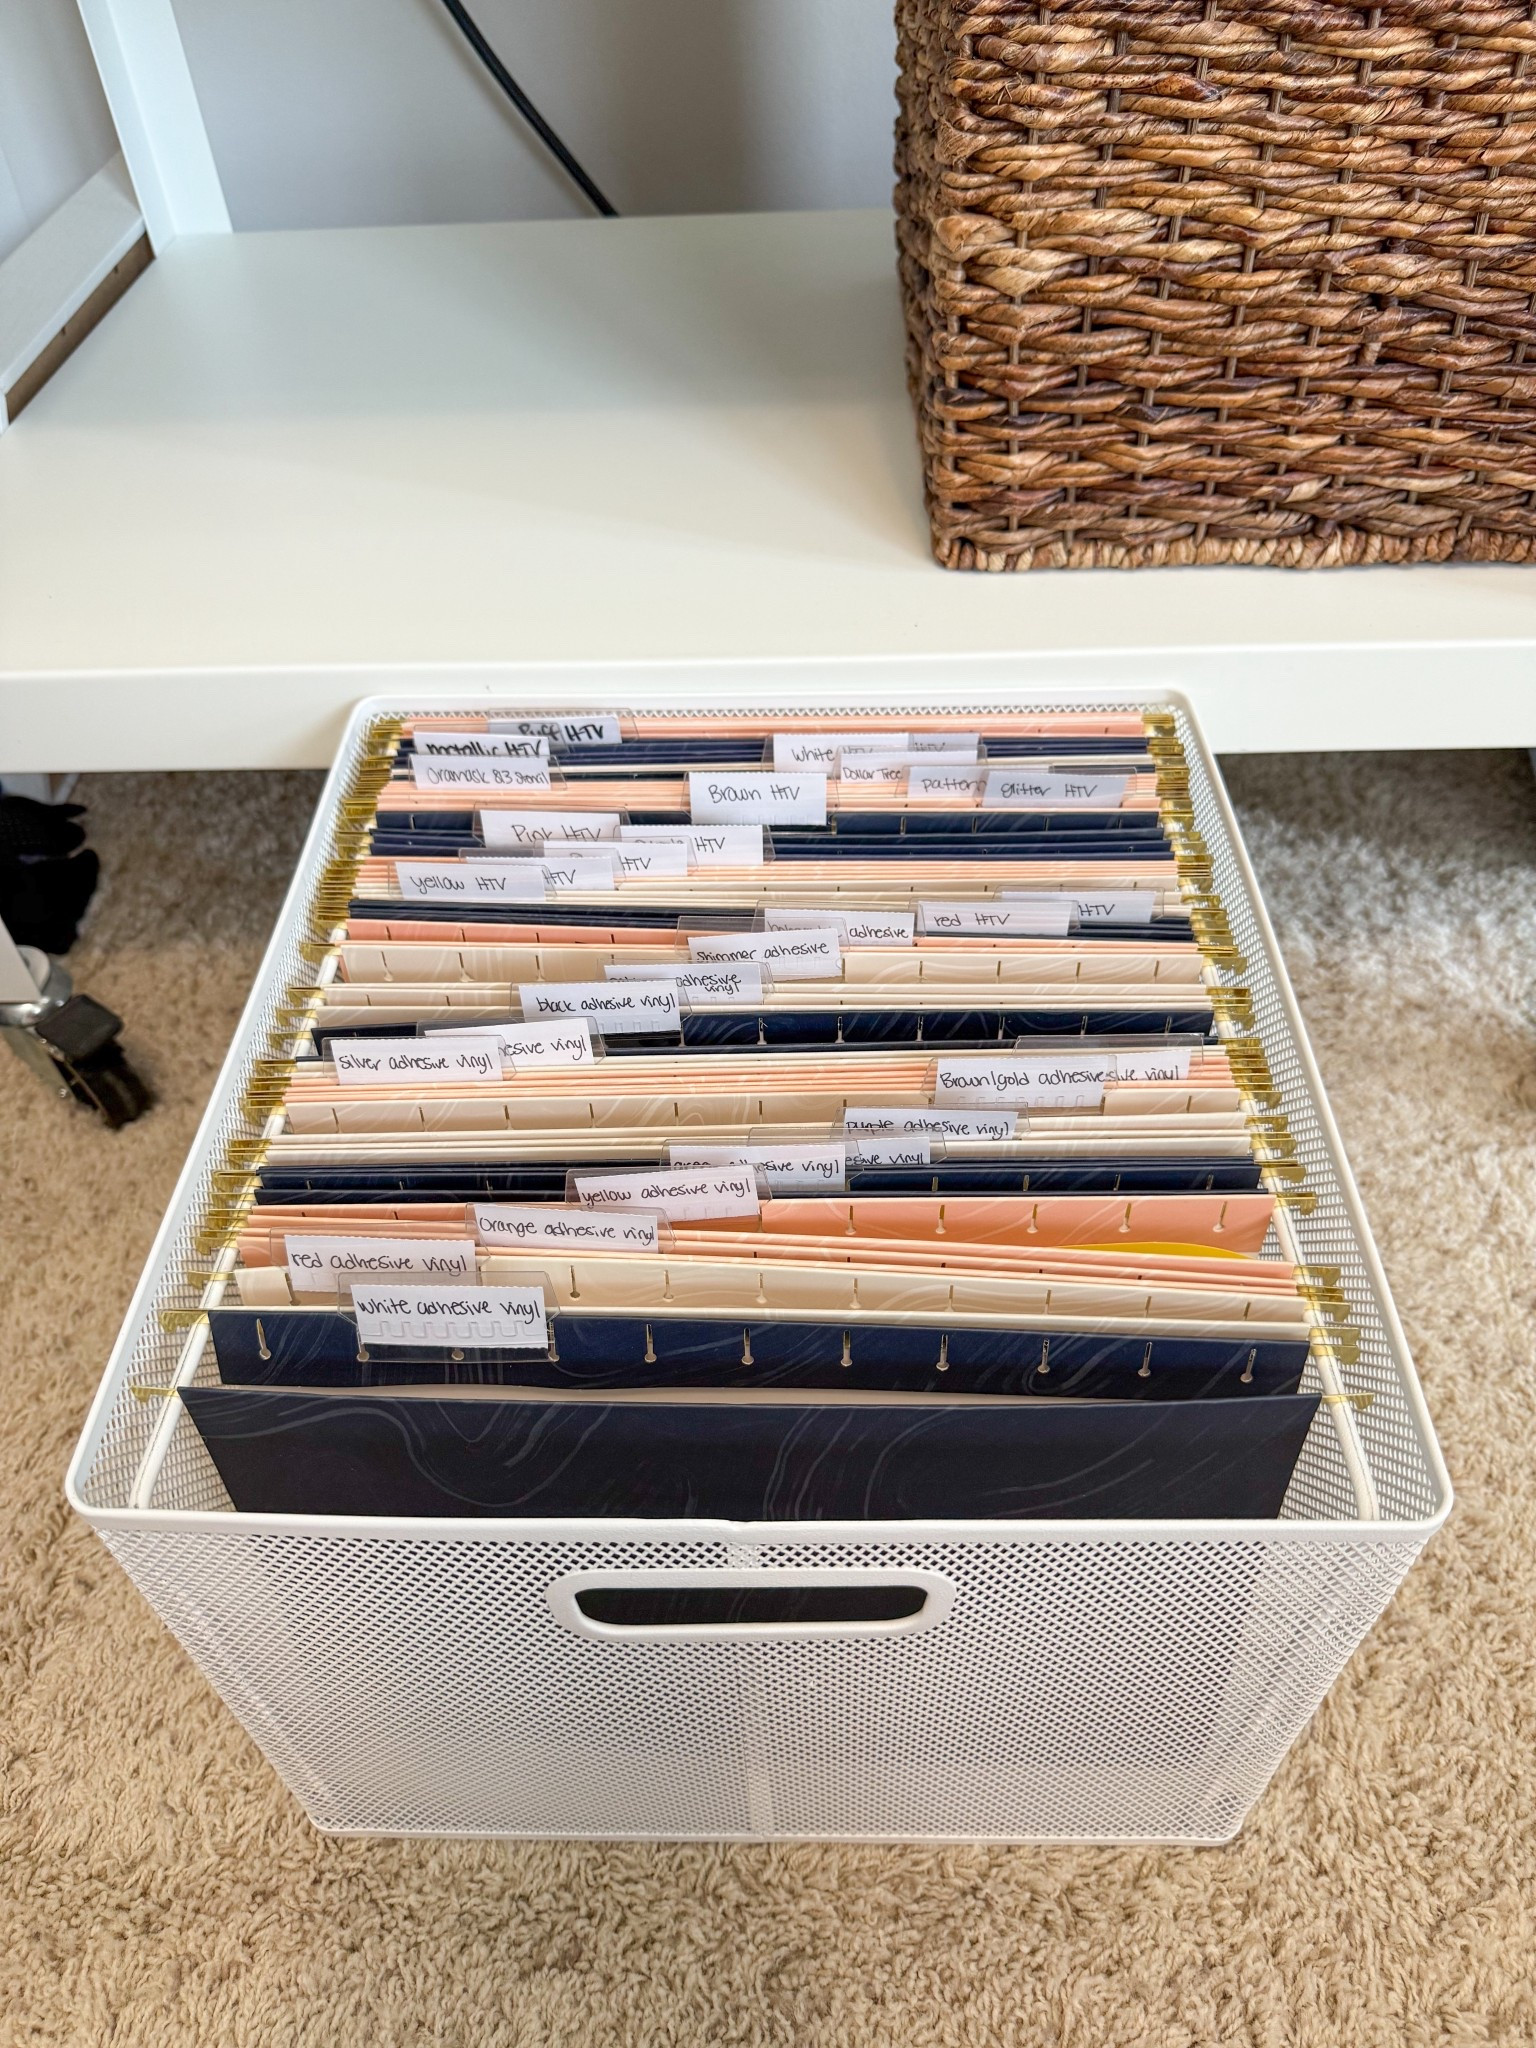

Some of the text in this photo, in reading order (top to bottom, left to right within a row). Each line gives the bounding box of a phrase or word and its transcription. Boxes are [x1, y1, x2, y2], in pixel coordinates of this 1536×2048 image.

[565, 725, 603, 741] HTV
[505, 740, 541, 757] HTV
[842, 767, 904, 780] Dollar Tree
[708, 784, 800, 804] Brown HTV
[1065, 784, 1098, 798] HTV
[561, 825, 601, 841] HTV
[694, 836, 725, 853] HTV
[620, 856, 651, 871] HTV
[475, 877, 506, 891] HTV
[542, 869, 576, 886] HTV
[1078, 903, 1115, 916] HTV
[934, 913, 1010, 928] red HTV
[849, 925, 909, 939] adhesive
[764, 942, 829, 959] adhesive
[676, 974, 741, 989] adhesive
[705, 983, 739, 996] vinyl
[537, 993, 676, 1016] black adhesive vinyl
[551, 1035, 587, 1060] vinyl
[389, 1054, 450, 1069] adhesive
[456, 1053, 493, 1074] vinyl
[1038, 1069, 1106, 1085] adhesive
[1145, 1065, 1179, 1080] vinyl
[904, 1119, 970, 1135] adhesive
[976, 1122, 1009, 1140] vinyl
[889, 1153, 923, 1165] vinyl
[802, 1159, 839, 1178] vinyl
[581, 1178, 750, 1209] yellow adhesive vinyl
[544, 1222, 616, 1238] adhesive
[623, 1225, 654, 1246] vinyl
[291, 1252, 467, 1276] red adhesive vinyl
[357, 1298, 541, 1325] white adhesive vinyl
